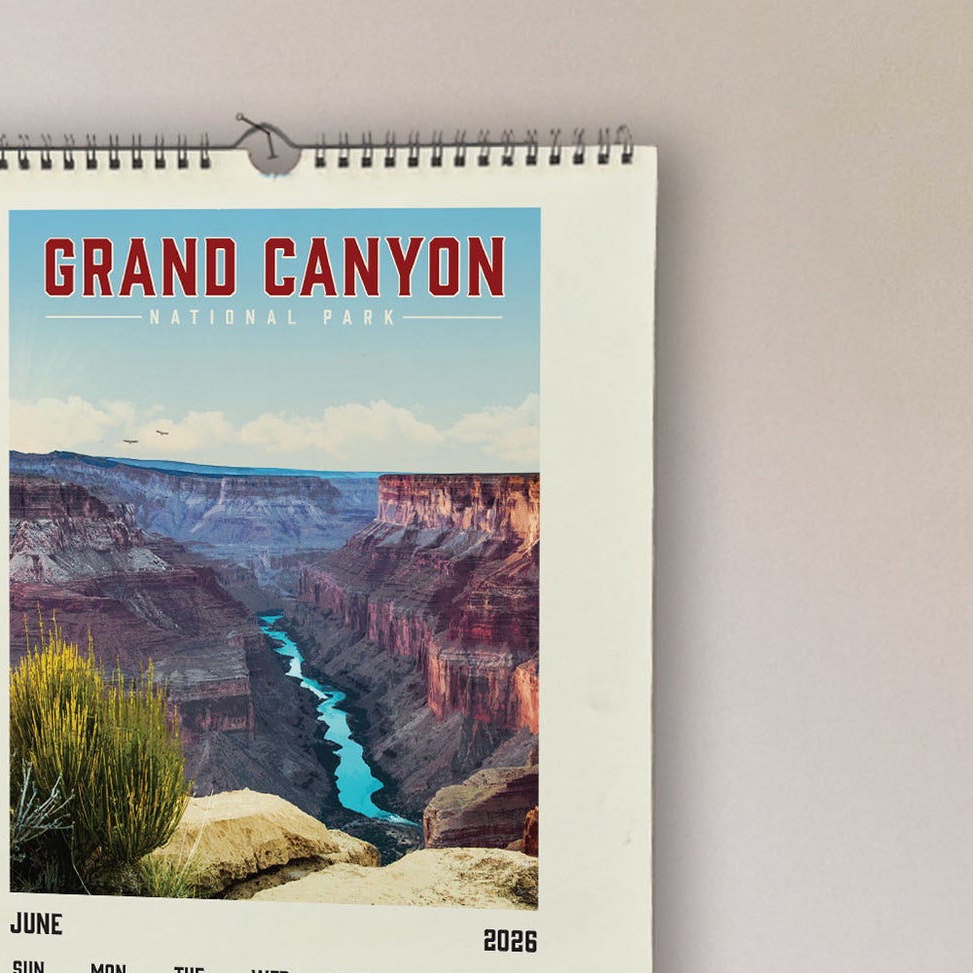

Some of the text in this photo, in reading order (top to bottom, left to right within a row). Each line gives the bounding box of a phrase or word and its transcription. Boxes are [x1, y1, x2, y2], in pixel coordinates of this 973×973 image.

[44, 236, 506, 297] GRAND CANYON
[150, 309, 395, 326] NATIONAL PARK
[11, 912, 63, 936] JUNE
[483, 928, 537, 953] 2026
